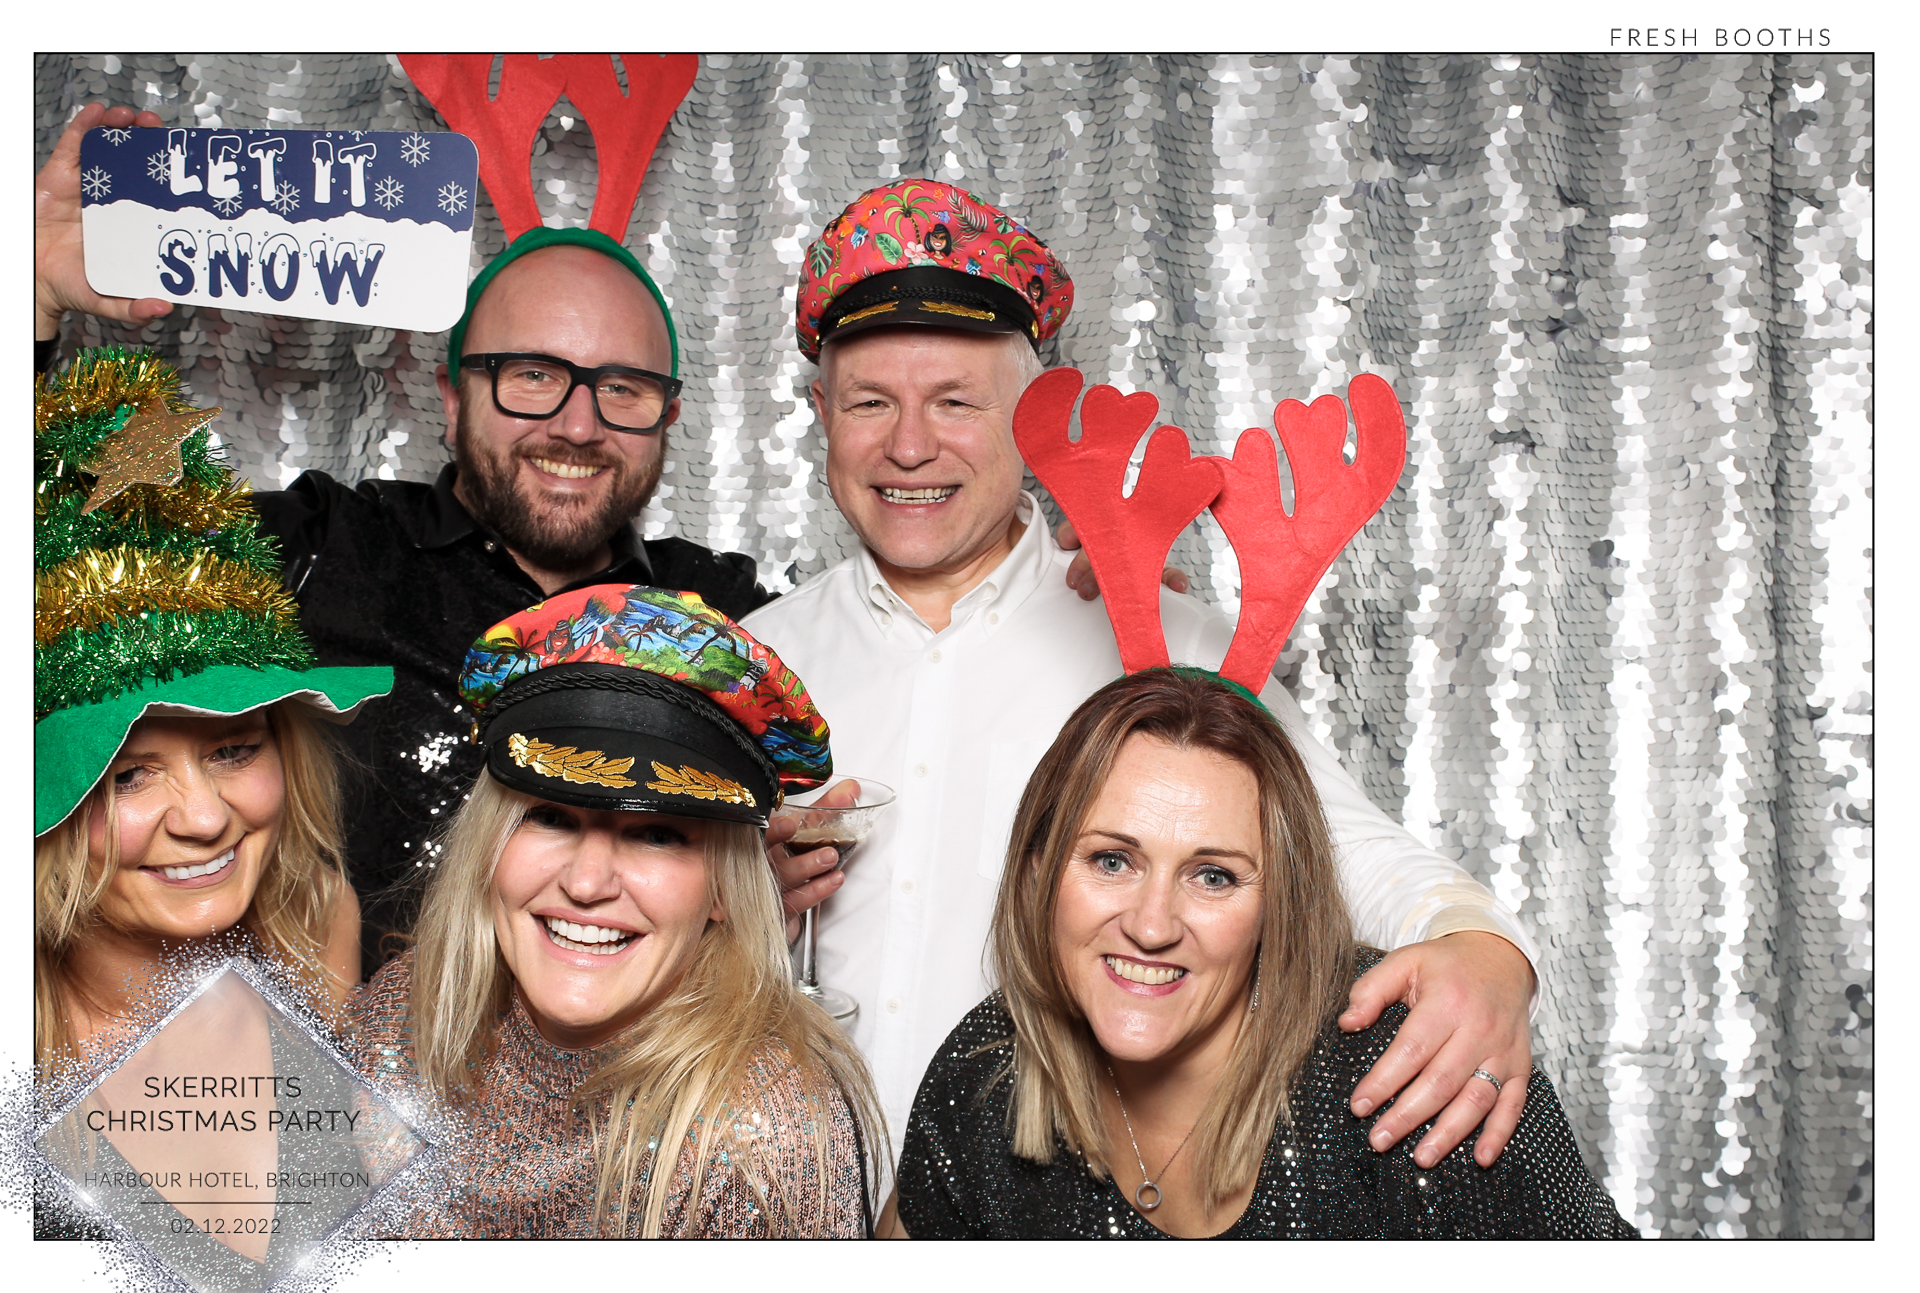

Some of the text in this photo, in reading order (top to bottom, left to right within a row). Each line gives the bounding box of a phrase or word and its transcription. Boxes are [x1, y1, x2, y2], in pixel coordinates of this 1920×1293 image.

[167, 128, 377, 207] LET IT
[158, 228, 386, 308] SNOW
